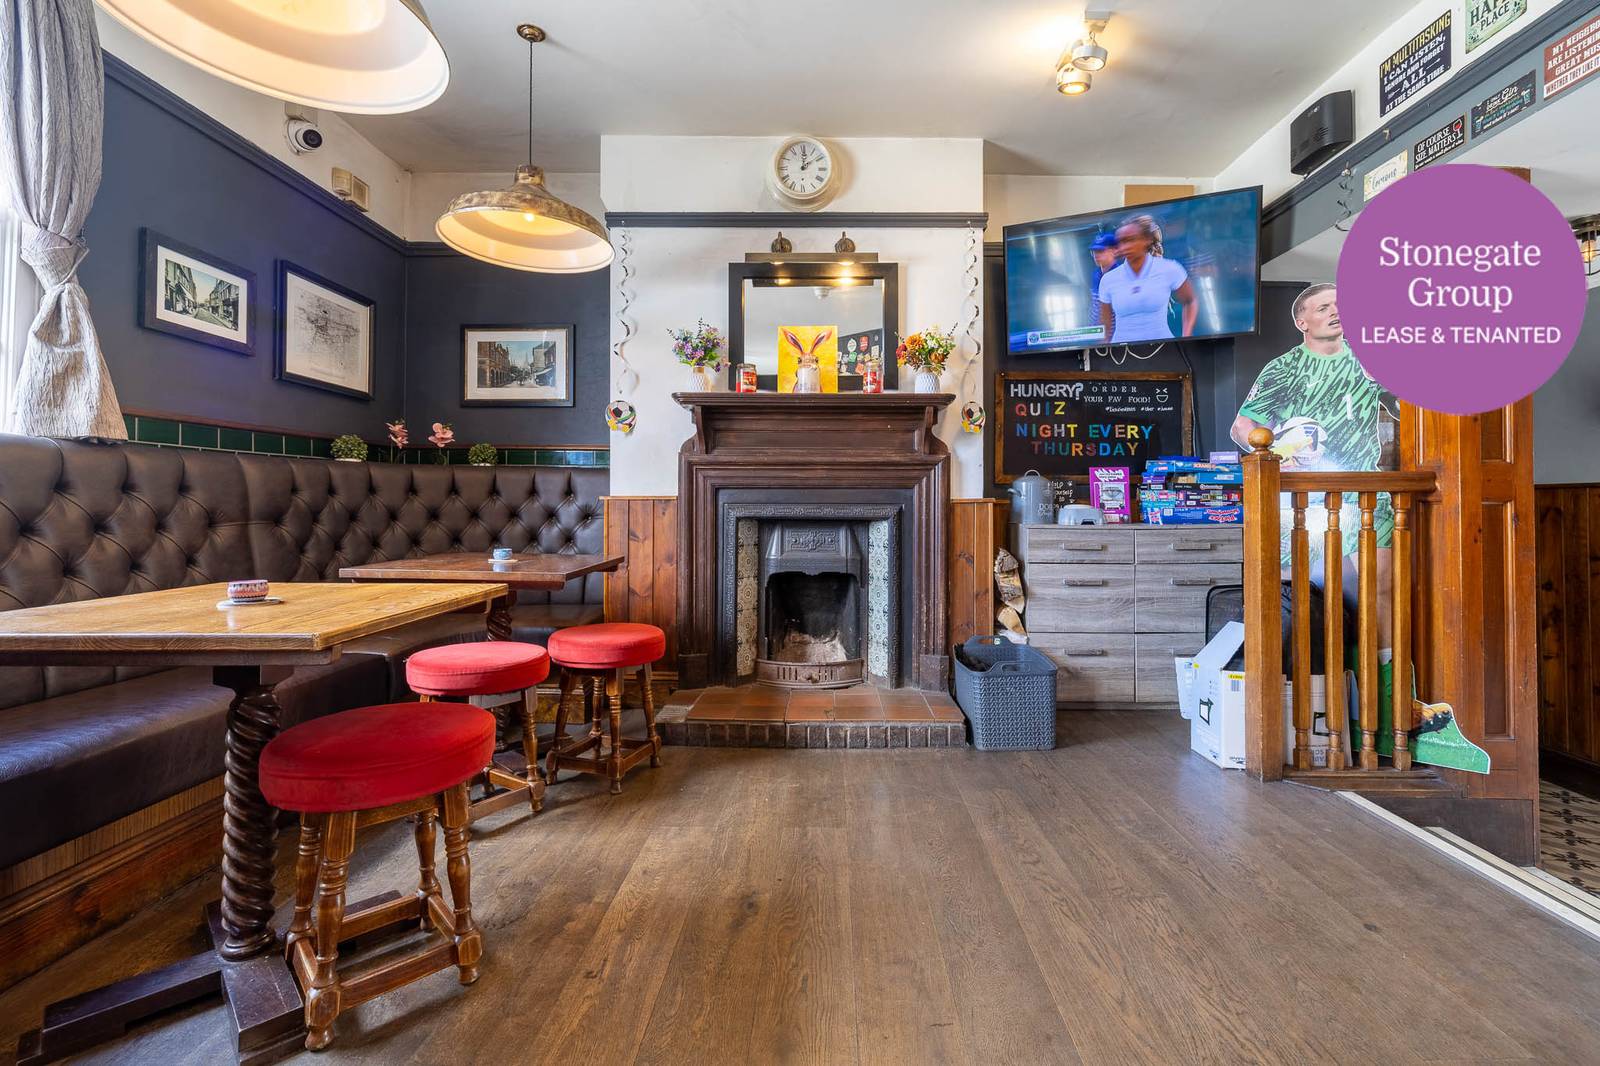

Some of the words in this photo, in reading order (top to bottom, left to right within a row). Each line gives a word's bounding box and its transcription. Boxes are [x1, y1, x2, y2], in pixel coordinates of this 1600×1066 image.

[1480, 1, 1510, 30] PLACE
[1380, 60, 1391, 78] I'M
[1392, 12, 1451, 65] MULTITASKING
[1389, 62, 1408, 81] CAN
[1547, 54, 1564, 70] ARE
[1555, 54, 1582, 76] GREAT
[1401, 68, 1426, 92] ALL
[1385, 101, 1394, 113] AT
[1407, 80, 1426, 97] SAME
[1415, 151, 1428, 163] SIZE
[1428, 133, 1456, 156] MATTERS
[1417, 140, 1426, 153] OF
[1426, 127, 1451, 148] COURSE
[1010, 383, 1083, 400] HUNGRY?
[1084, 395, 1103, 403] YOUR
[1015, 401, 1065, 417] QUIZ
[1016, 423, 1078, 439] NIGHT
[1088, 423, 1153, 439] EVERY
[1032, 441, 1139, 457] THURSDAY
